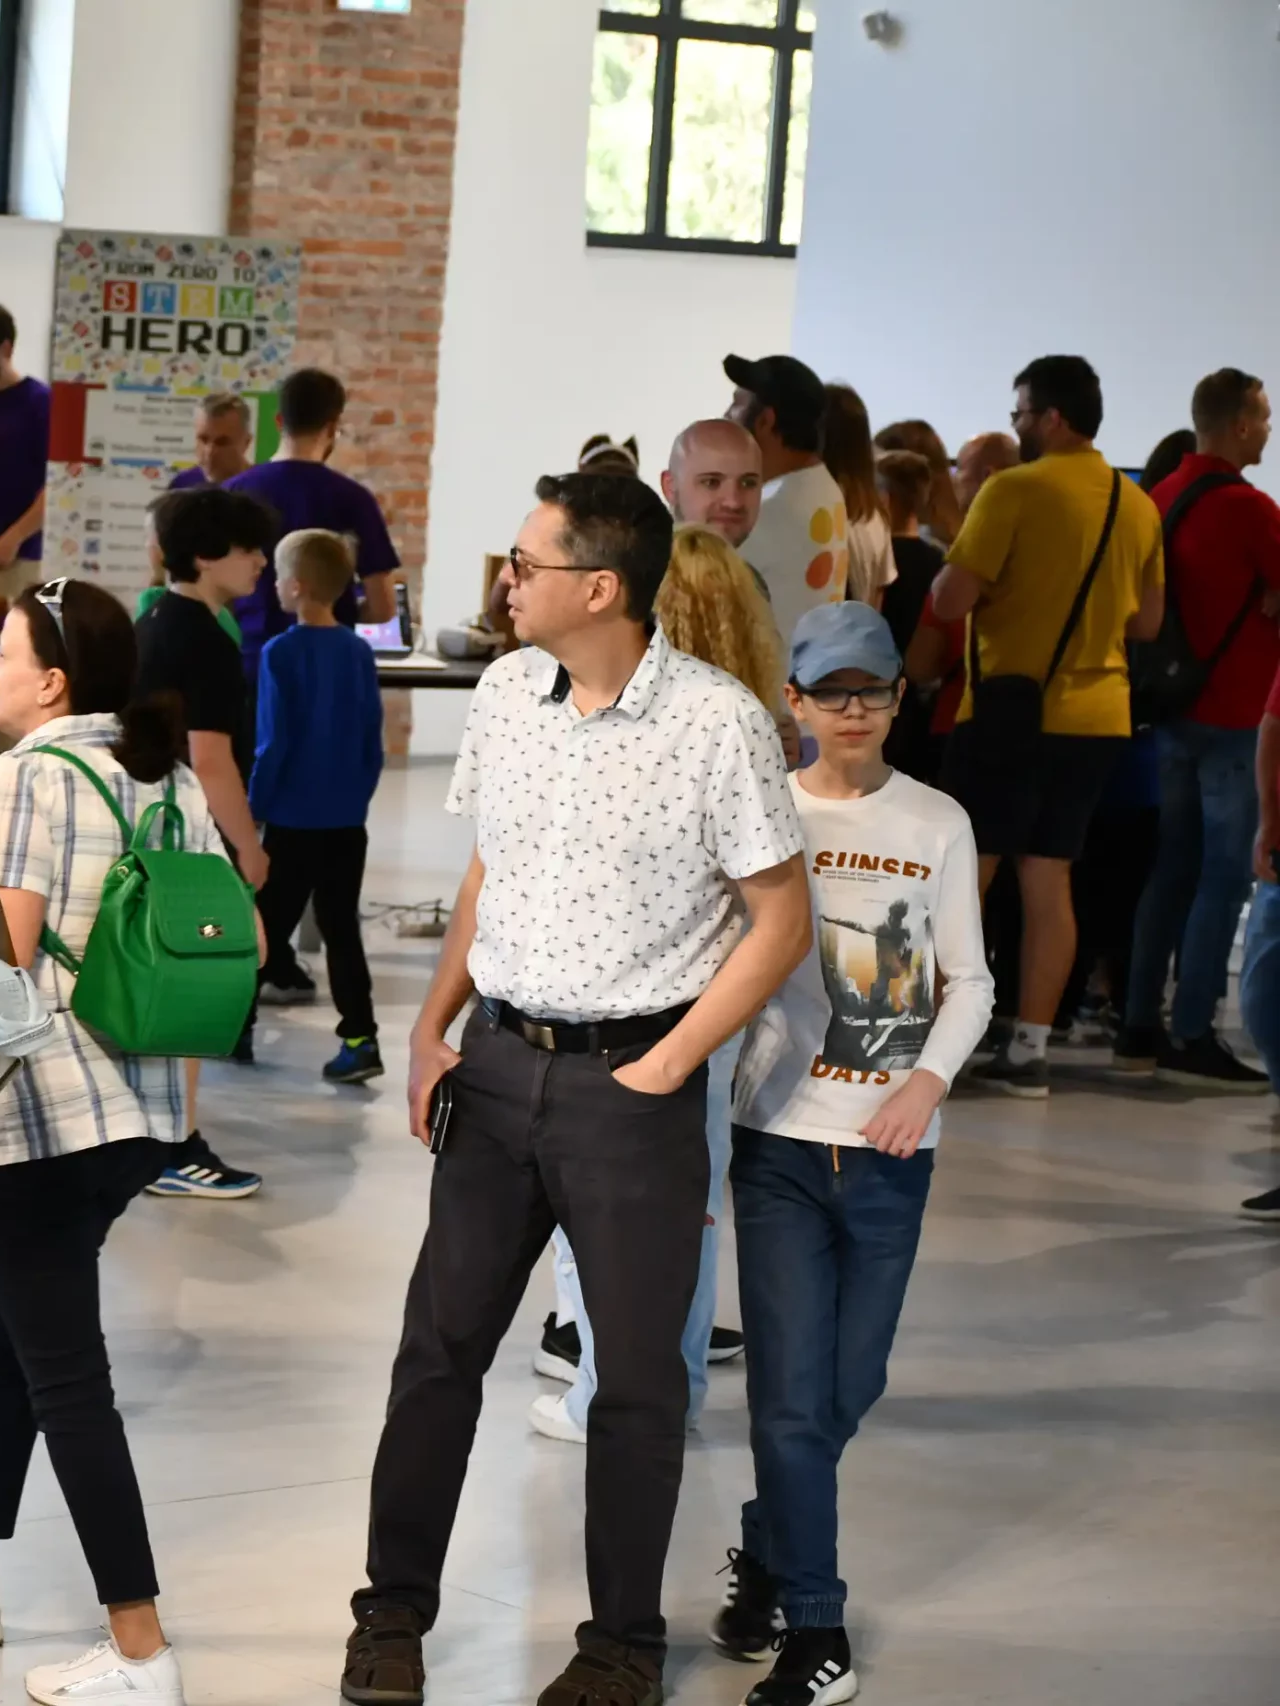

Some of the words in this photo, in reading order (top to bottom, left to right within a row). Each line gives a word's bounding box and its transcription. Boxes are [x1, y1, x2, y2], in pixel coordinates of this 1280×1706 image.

[104, 261, 155, 277] FROM
[167, 263, 218, 280] ZERO
[232, 266, 256, 282] TO
[109, 282, 251, 317] STEM
[101, 315, 252, 357] HERO
